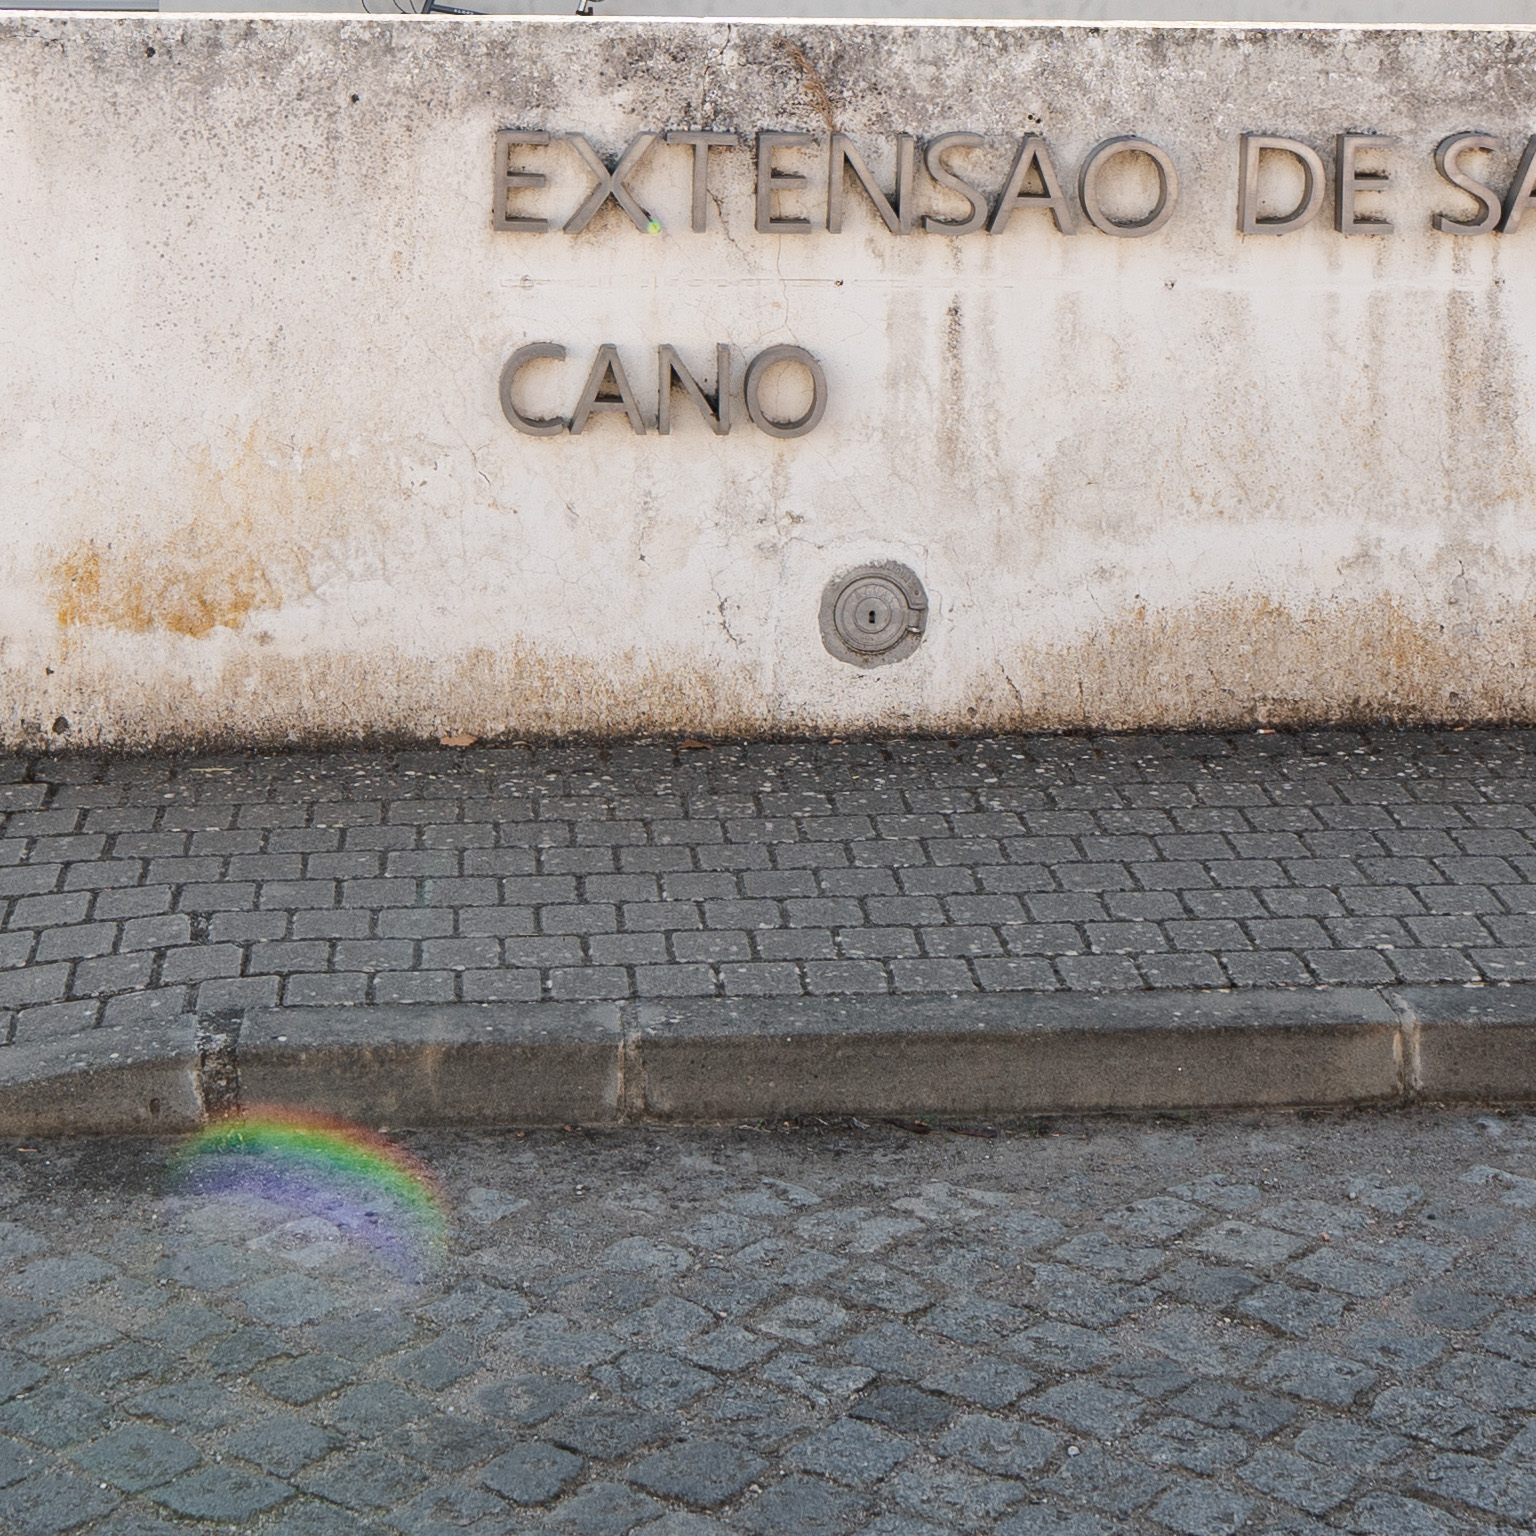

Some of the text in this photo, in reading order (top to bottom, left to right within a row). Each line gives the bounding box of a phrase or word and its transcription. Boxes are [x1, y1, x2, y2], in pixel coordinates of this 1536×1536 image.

[493, 129, 1179, 237] EXTENSAO
[1237, 131, 1396, 236] DE
[499, 342, 828, 439] CANO
